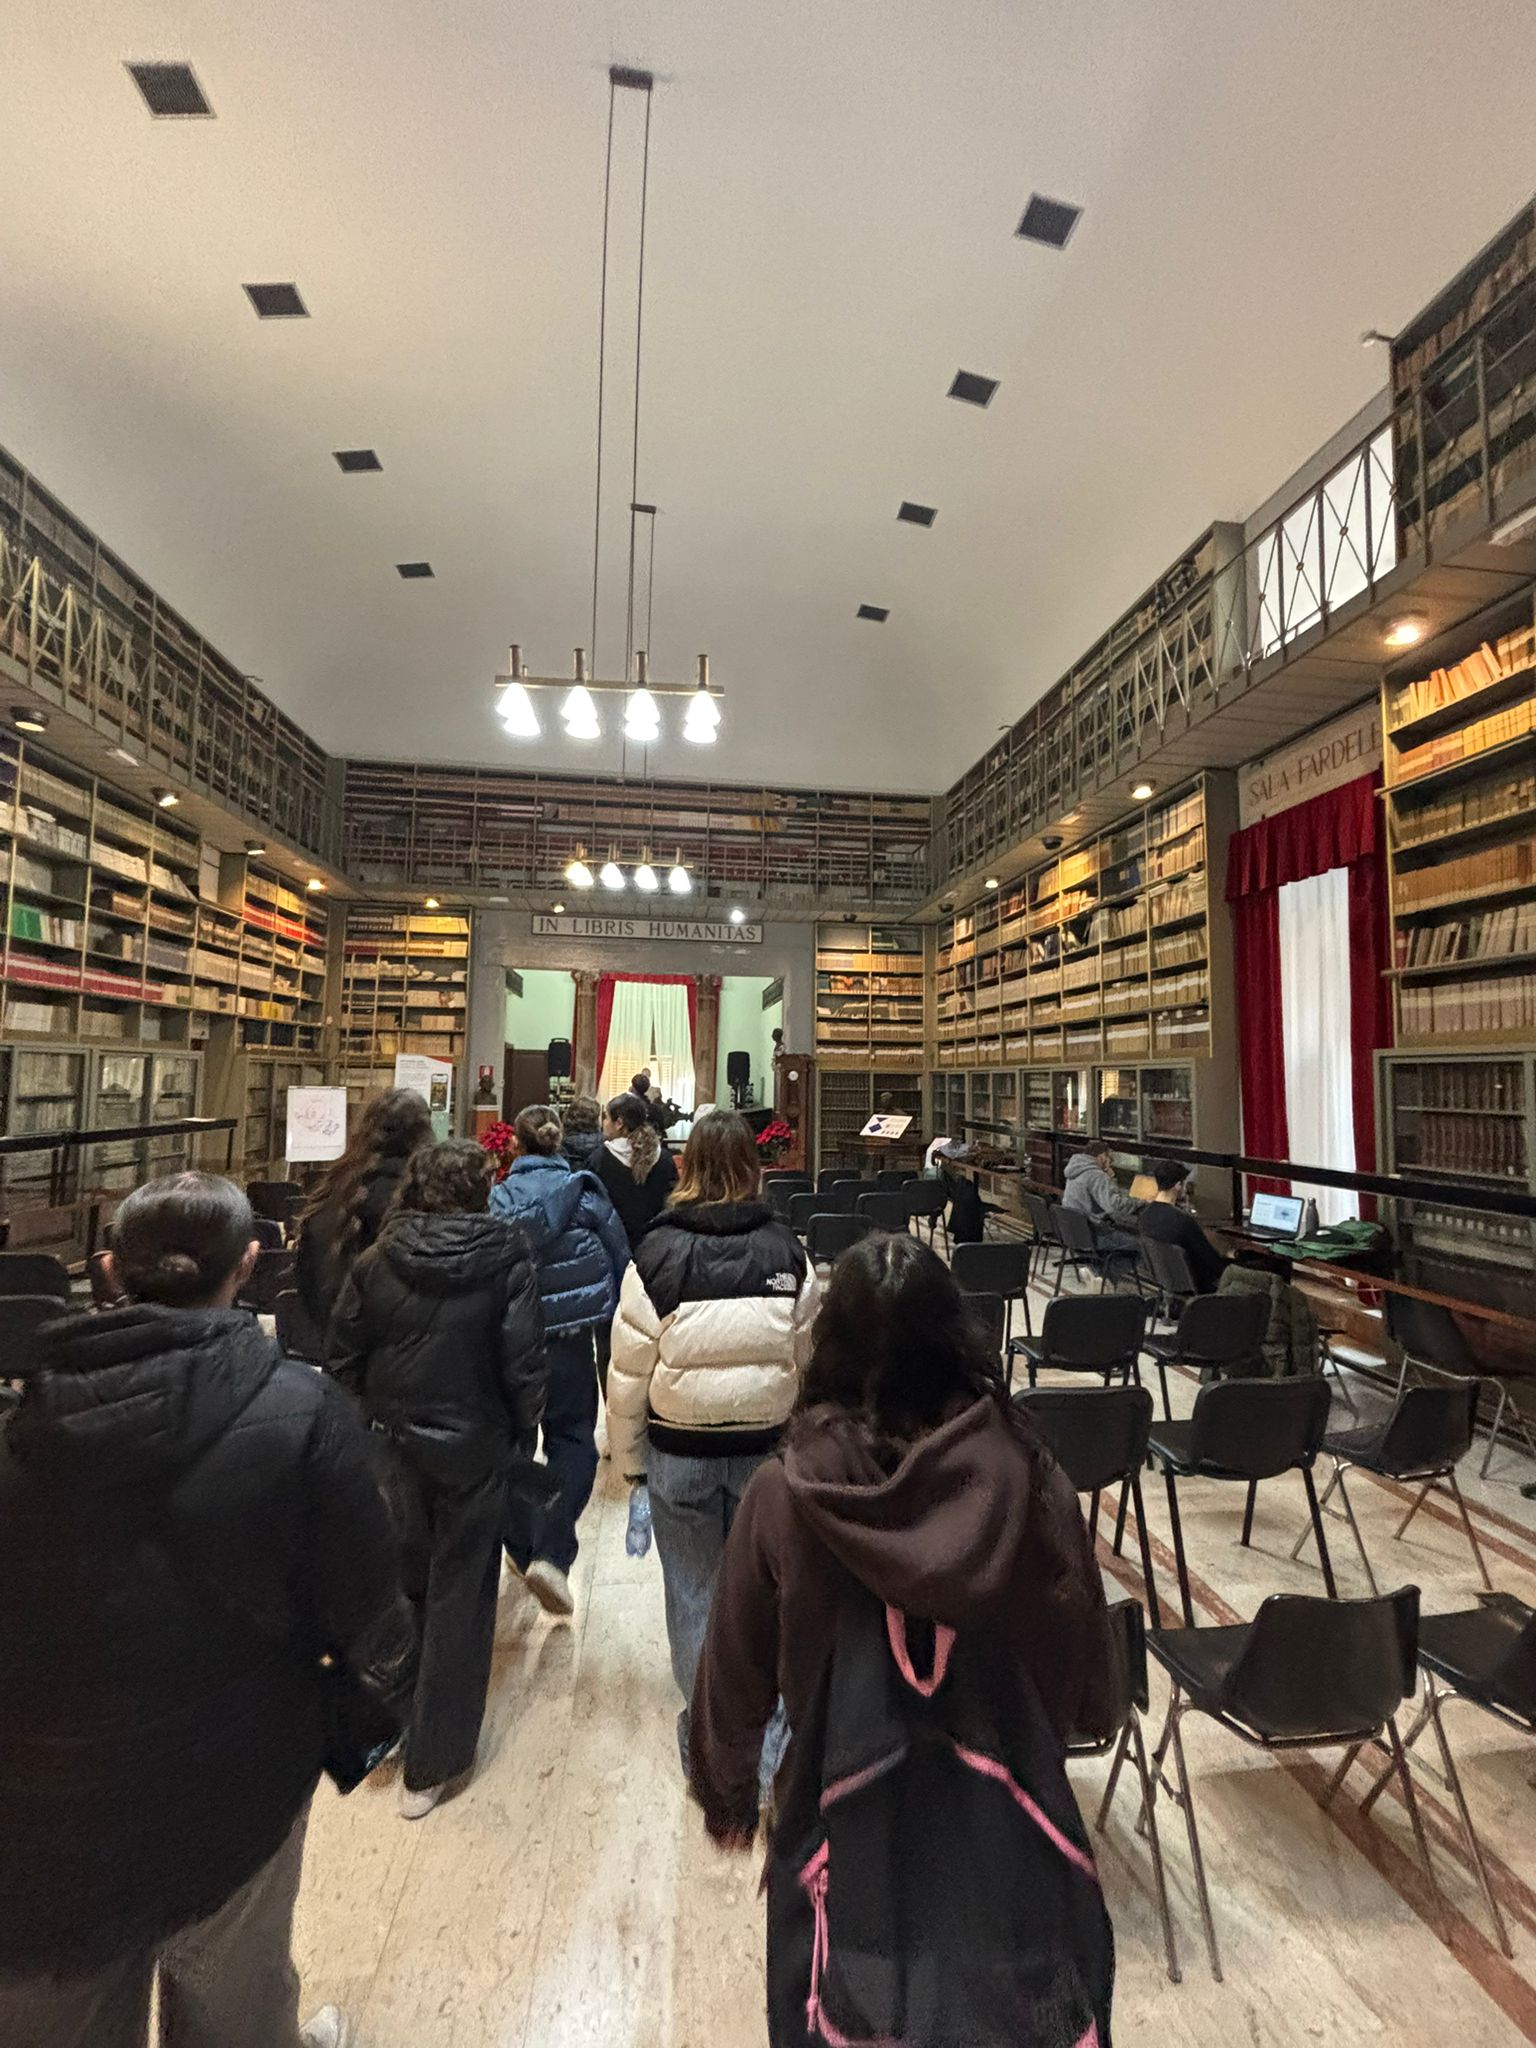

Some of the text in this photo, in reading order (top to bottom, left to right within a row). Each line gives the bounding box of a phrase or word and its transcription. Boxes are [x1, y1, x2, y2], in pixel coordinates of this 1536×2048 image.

[1247, 770, 1290, 806] SALA
[539, 917, 756, 941] IN LIBRIS HUMANITAS
